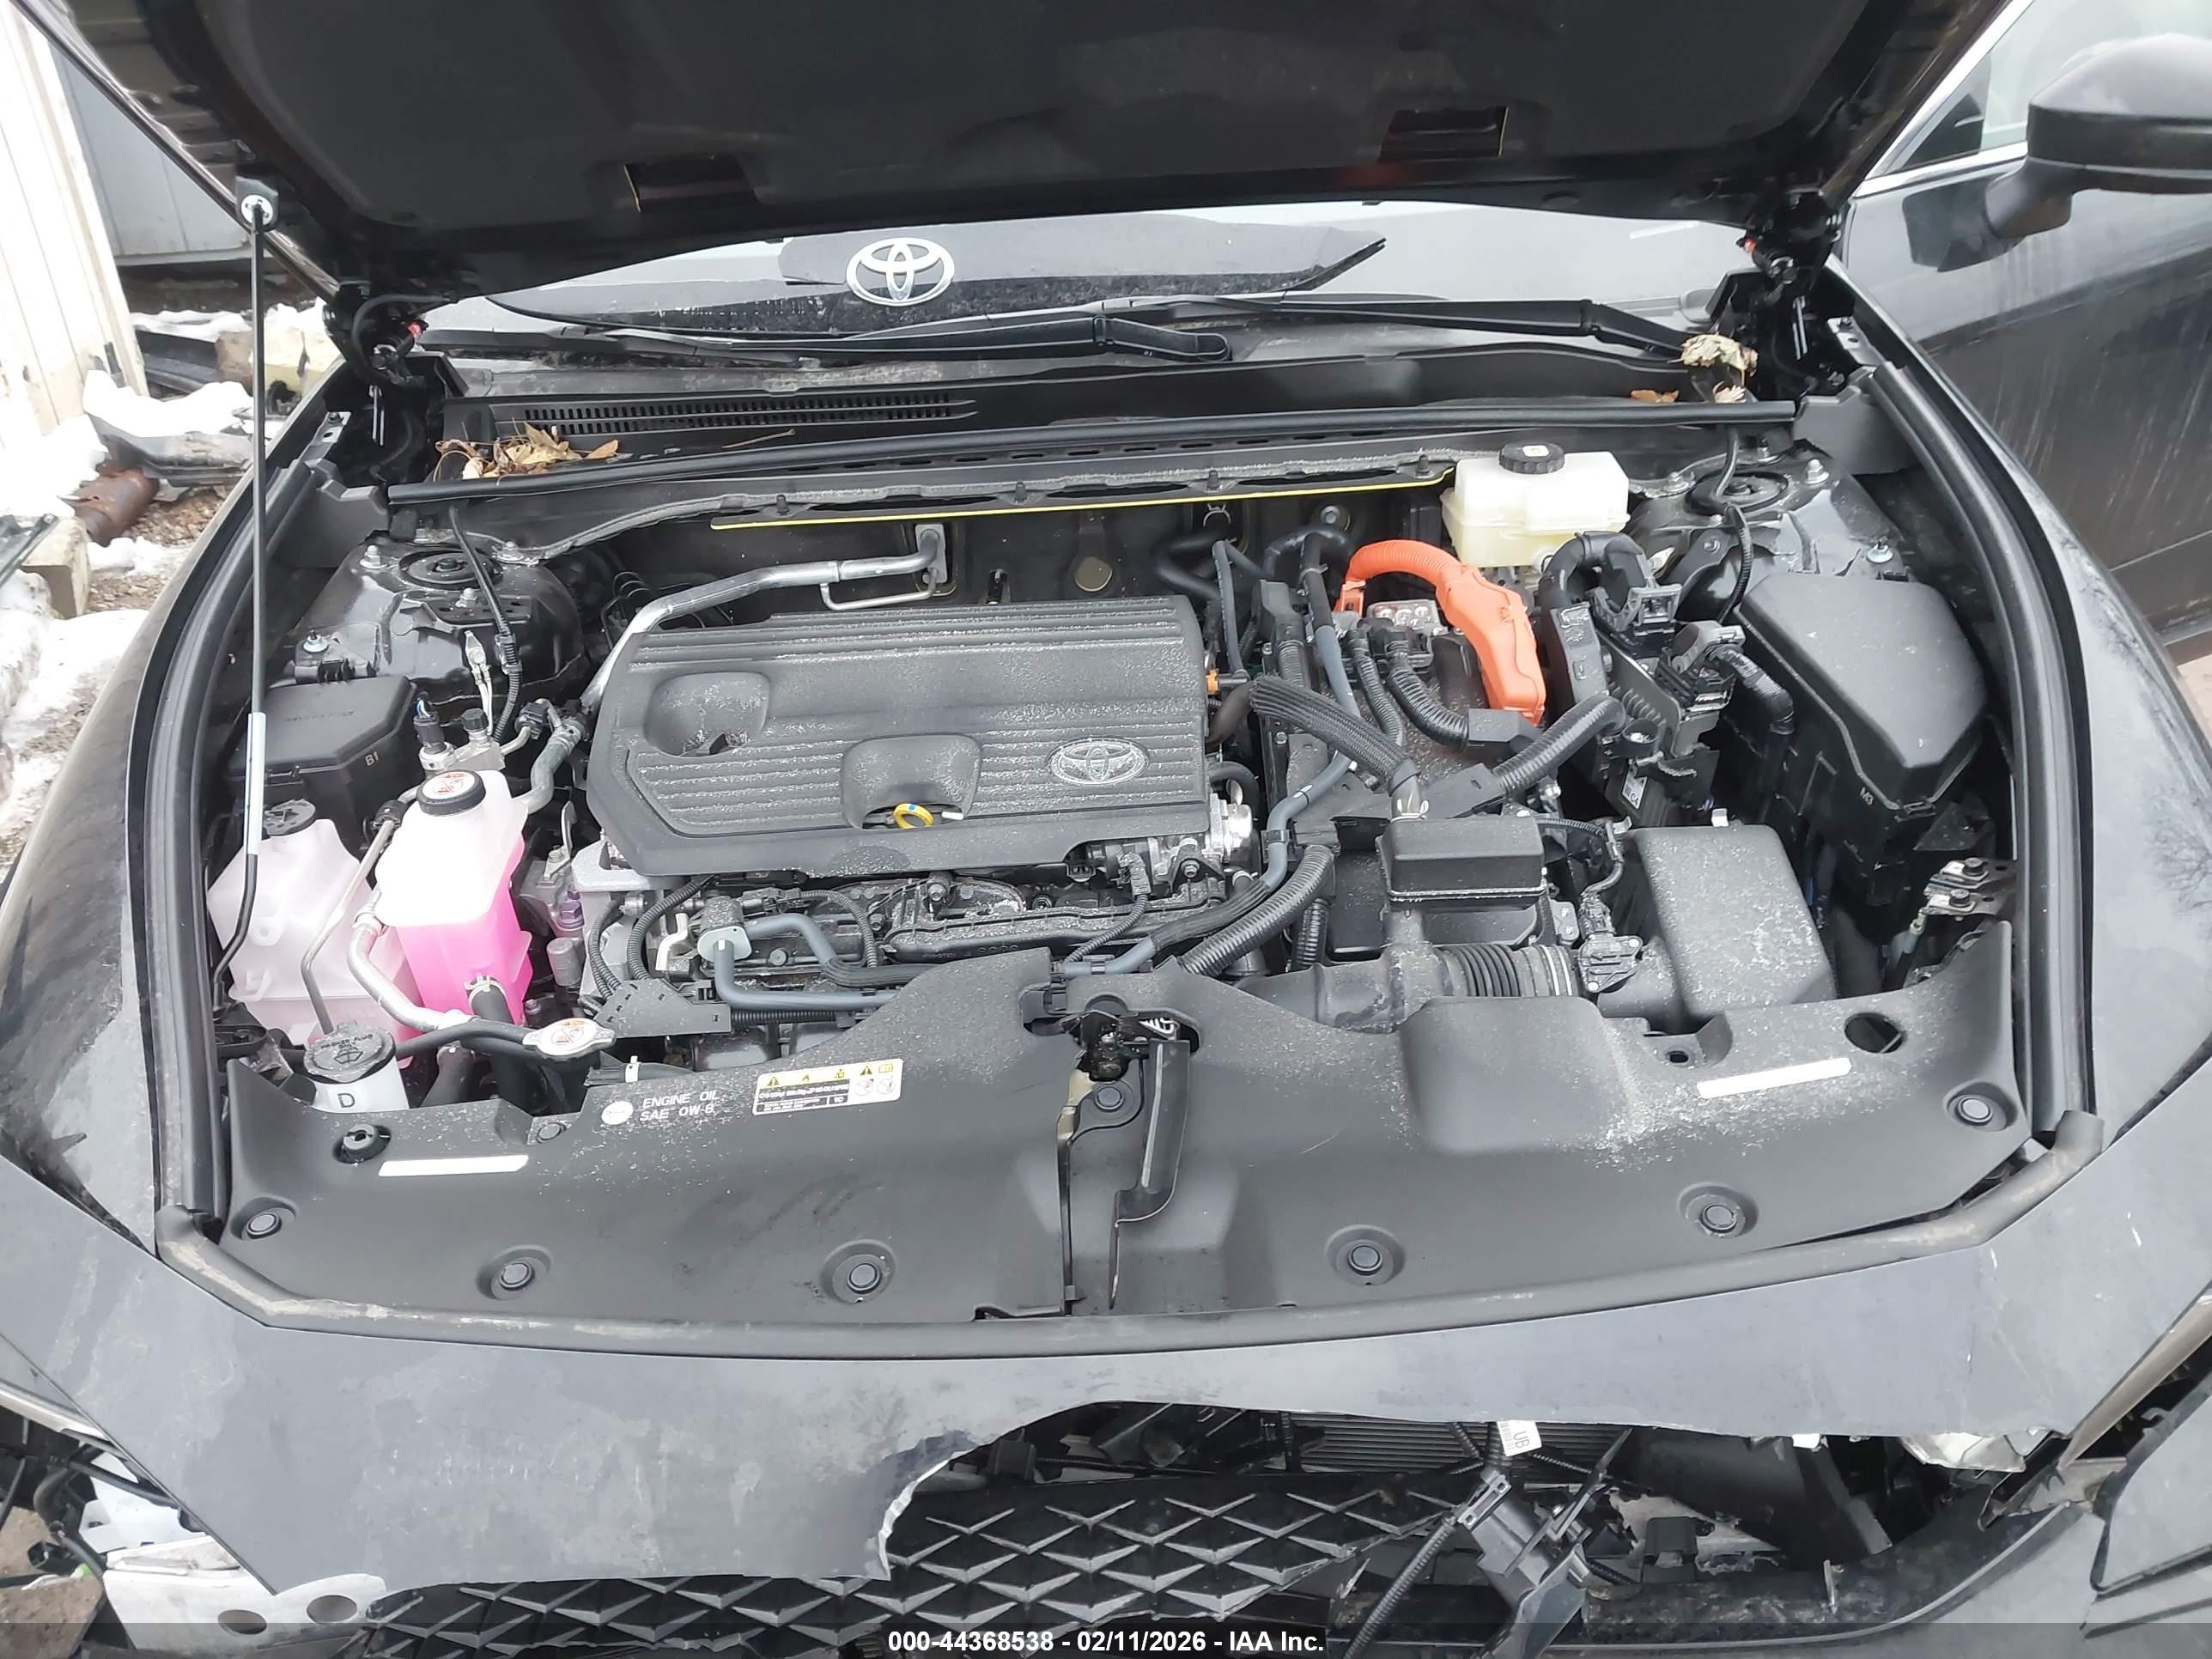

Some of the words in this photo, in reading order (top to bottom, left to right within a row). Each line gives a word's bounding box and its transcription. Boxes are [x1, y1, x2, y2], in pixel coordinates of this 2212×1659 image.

[365, 751, 379, 766] B1
[337, 1092, 356, 1109] D
[642, 1093, 691, 1108] ENGINE
[699, 1090, 720, 1102] OIL
[639, 1109, 670, 1121] SAE
[1513, 1431, 1529, 1449] UB
